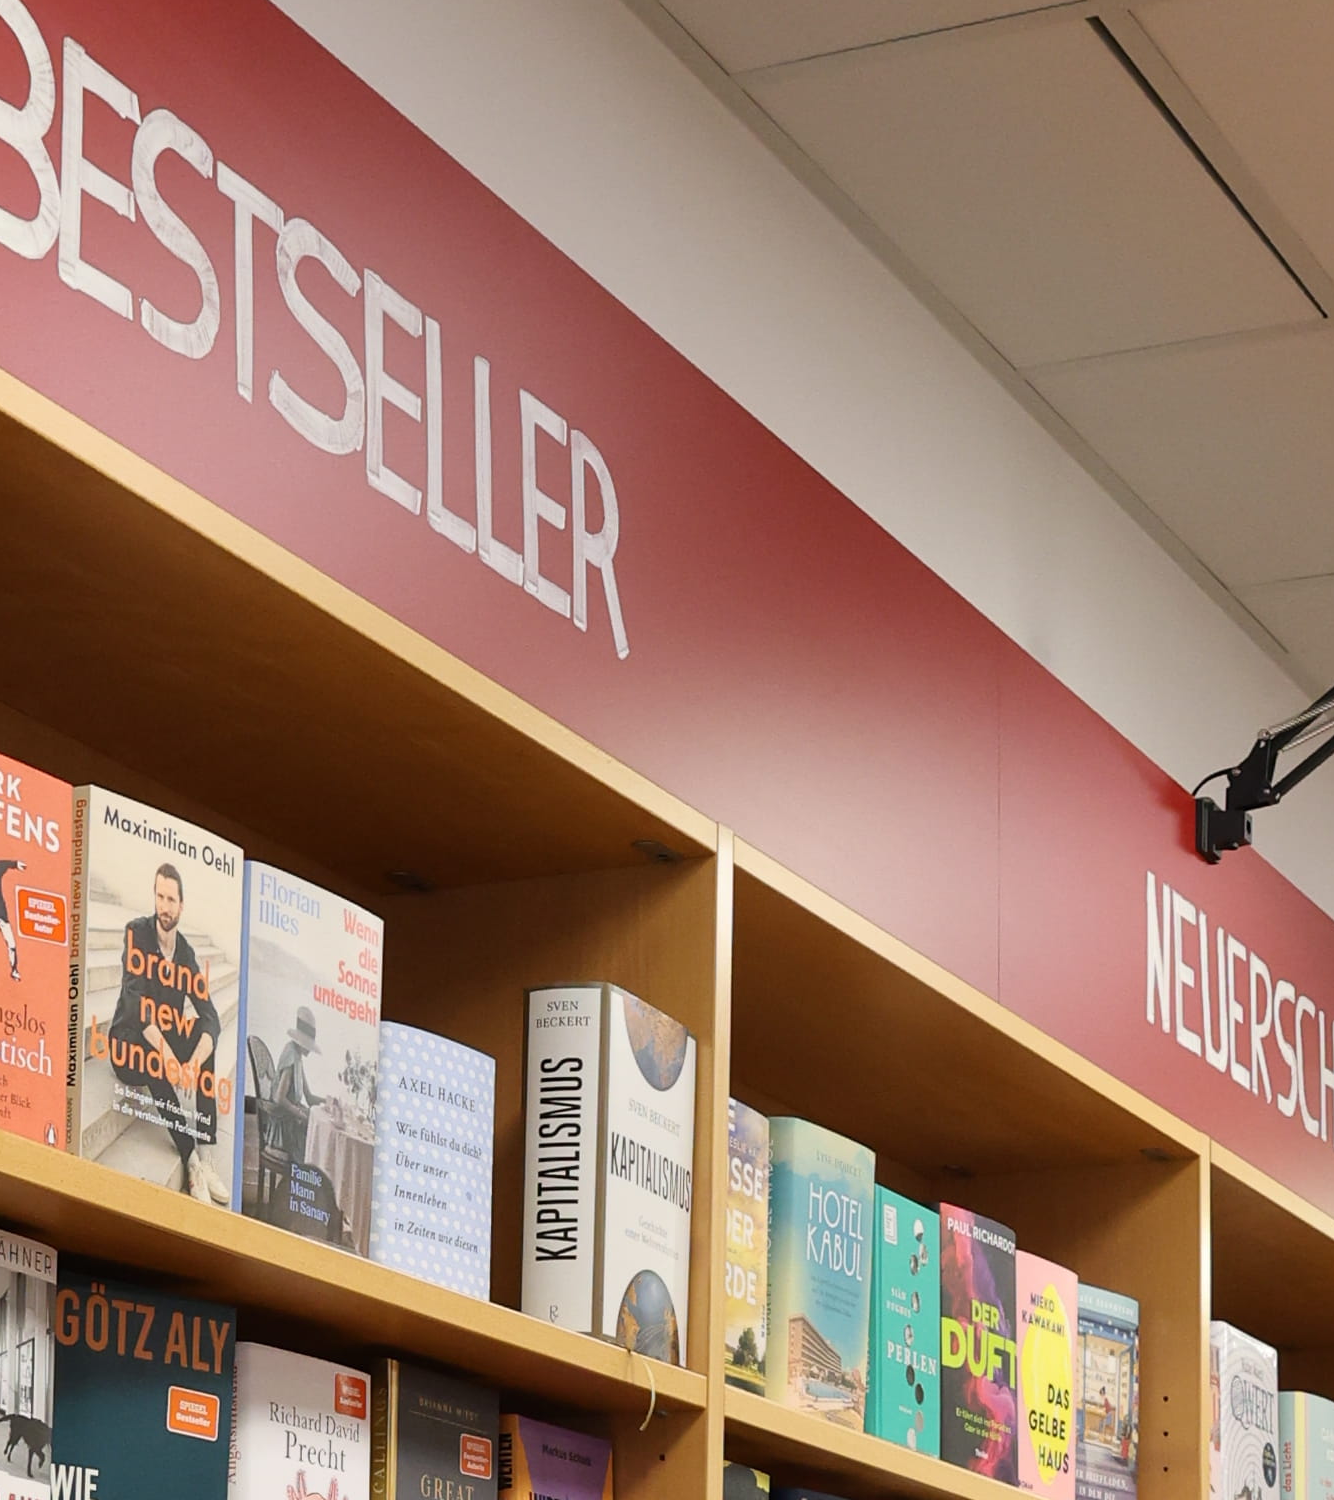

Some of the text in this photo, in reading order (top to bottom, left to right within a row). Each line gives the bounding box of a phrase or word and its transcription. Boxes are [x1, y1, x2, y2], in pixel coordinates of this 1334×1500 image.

[343, 908, 380, 946] Wenn
[125, 928, 210, 1001] brand
[140, 989, 197, 1040] new
[535, 1016, 592, 1030] BECKERT
[536, 1056, 583, 1262] KAPITALISMUS
[971, 1300, 999, 1331] DER
[1048, 1383, 1069, 1410] DAS
[269, 1401, 360, 1443] Richard David
[1283, 1442, 1292, 1473] Licht
[1283, 1476, 1292, 1492] das
